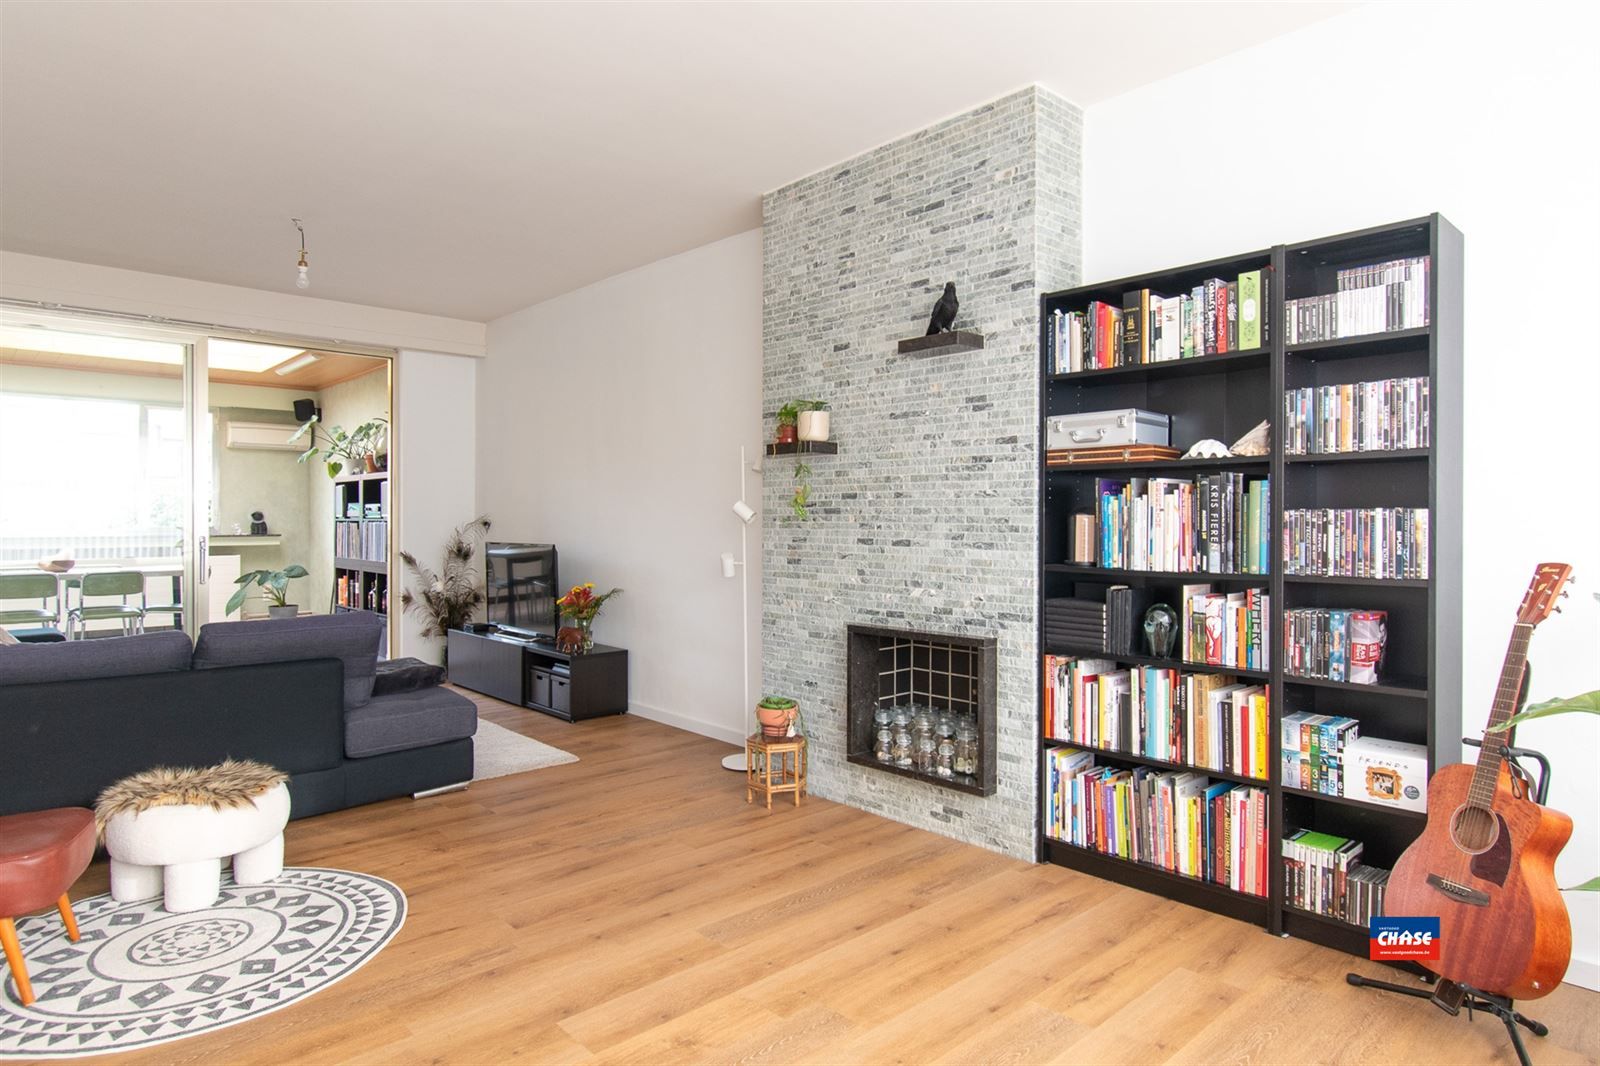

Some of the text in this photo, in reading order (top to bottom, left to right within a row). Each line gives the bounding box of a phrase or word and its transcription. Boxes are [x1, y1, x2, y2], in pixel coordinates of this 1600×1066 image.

[1210, 485, 1219, 508] KRIS
[1311, 733, 1319, 747] LOST
[1358, 756, 1408, 770] FRIENDS
[1302, 768, 1308, 778] 2
[1312, 769, 1318, 779] 3
[1330, 780, 1336, 789] 5
[1337, 781, 1343, 790] 6
